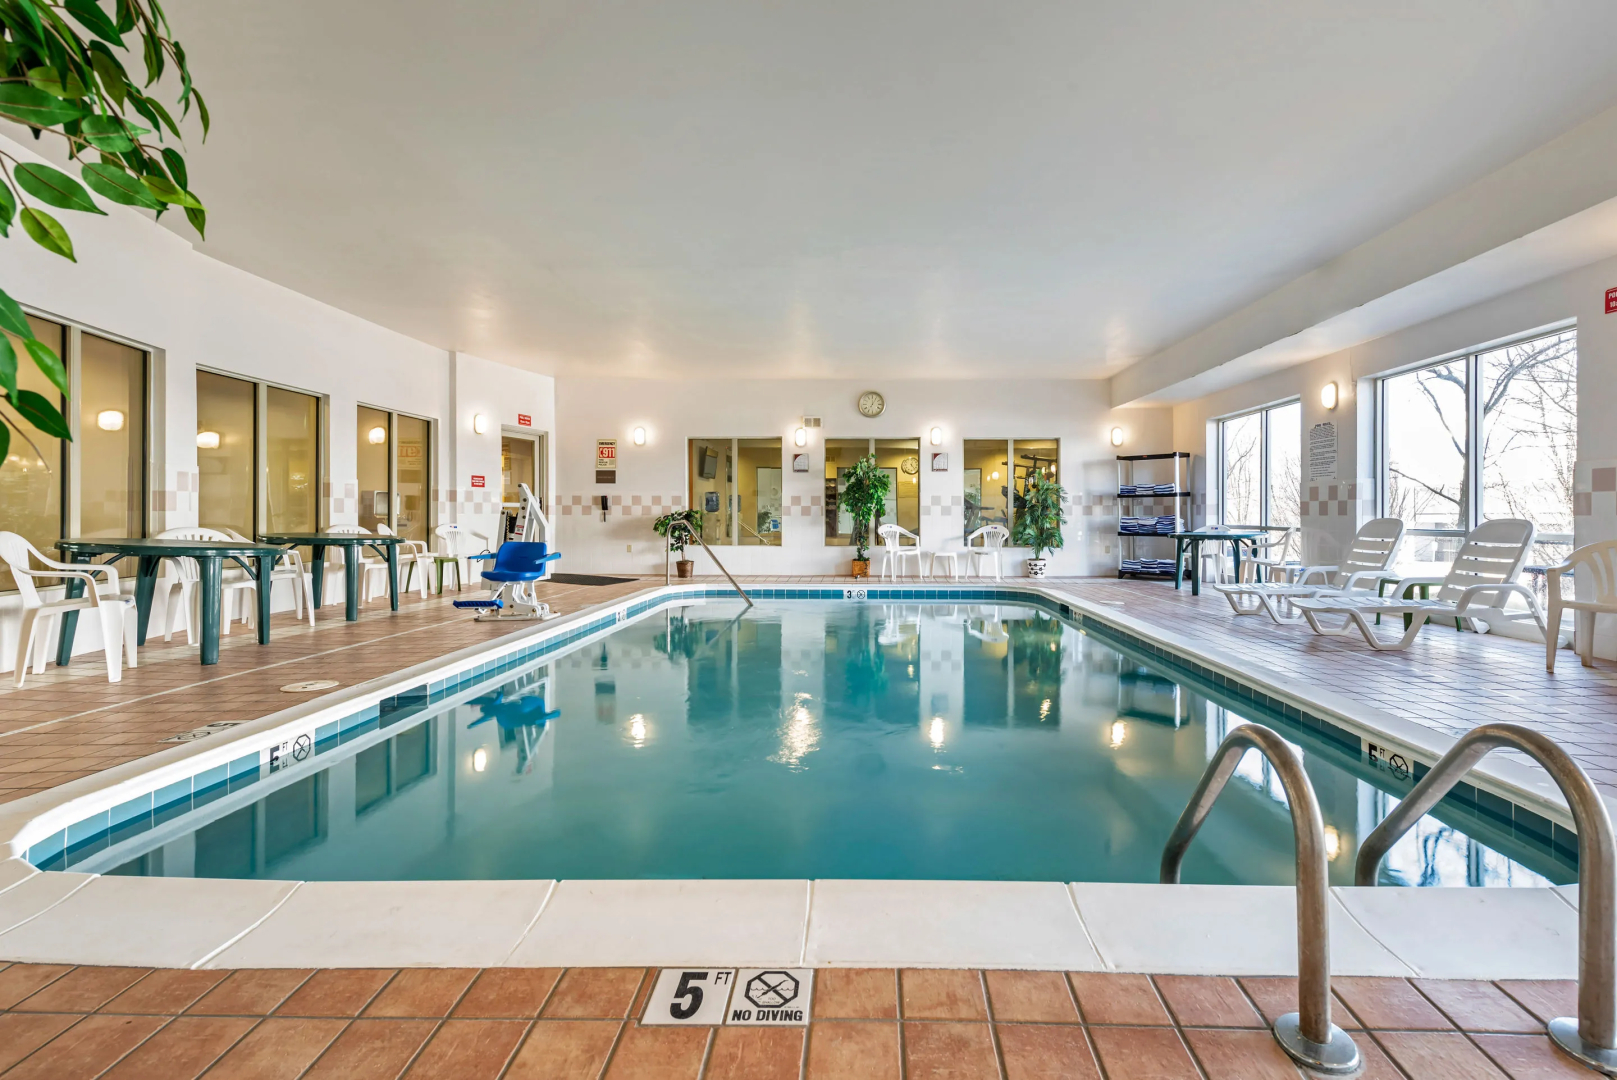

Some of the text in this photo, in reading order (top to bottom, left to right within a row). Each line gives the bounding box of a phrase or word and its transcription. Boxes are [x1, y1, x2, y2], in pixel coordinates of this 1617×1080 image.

[603, 447, 615, 458] 911
[846, 590, 852, 599] 3
[669, 971, 732, 1020] 5 FT
[731, 1009, 803, 1021] NO DIVING
